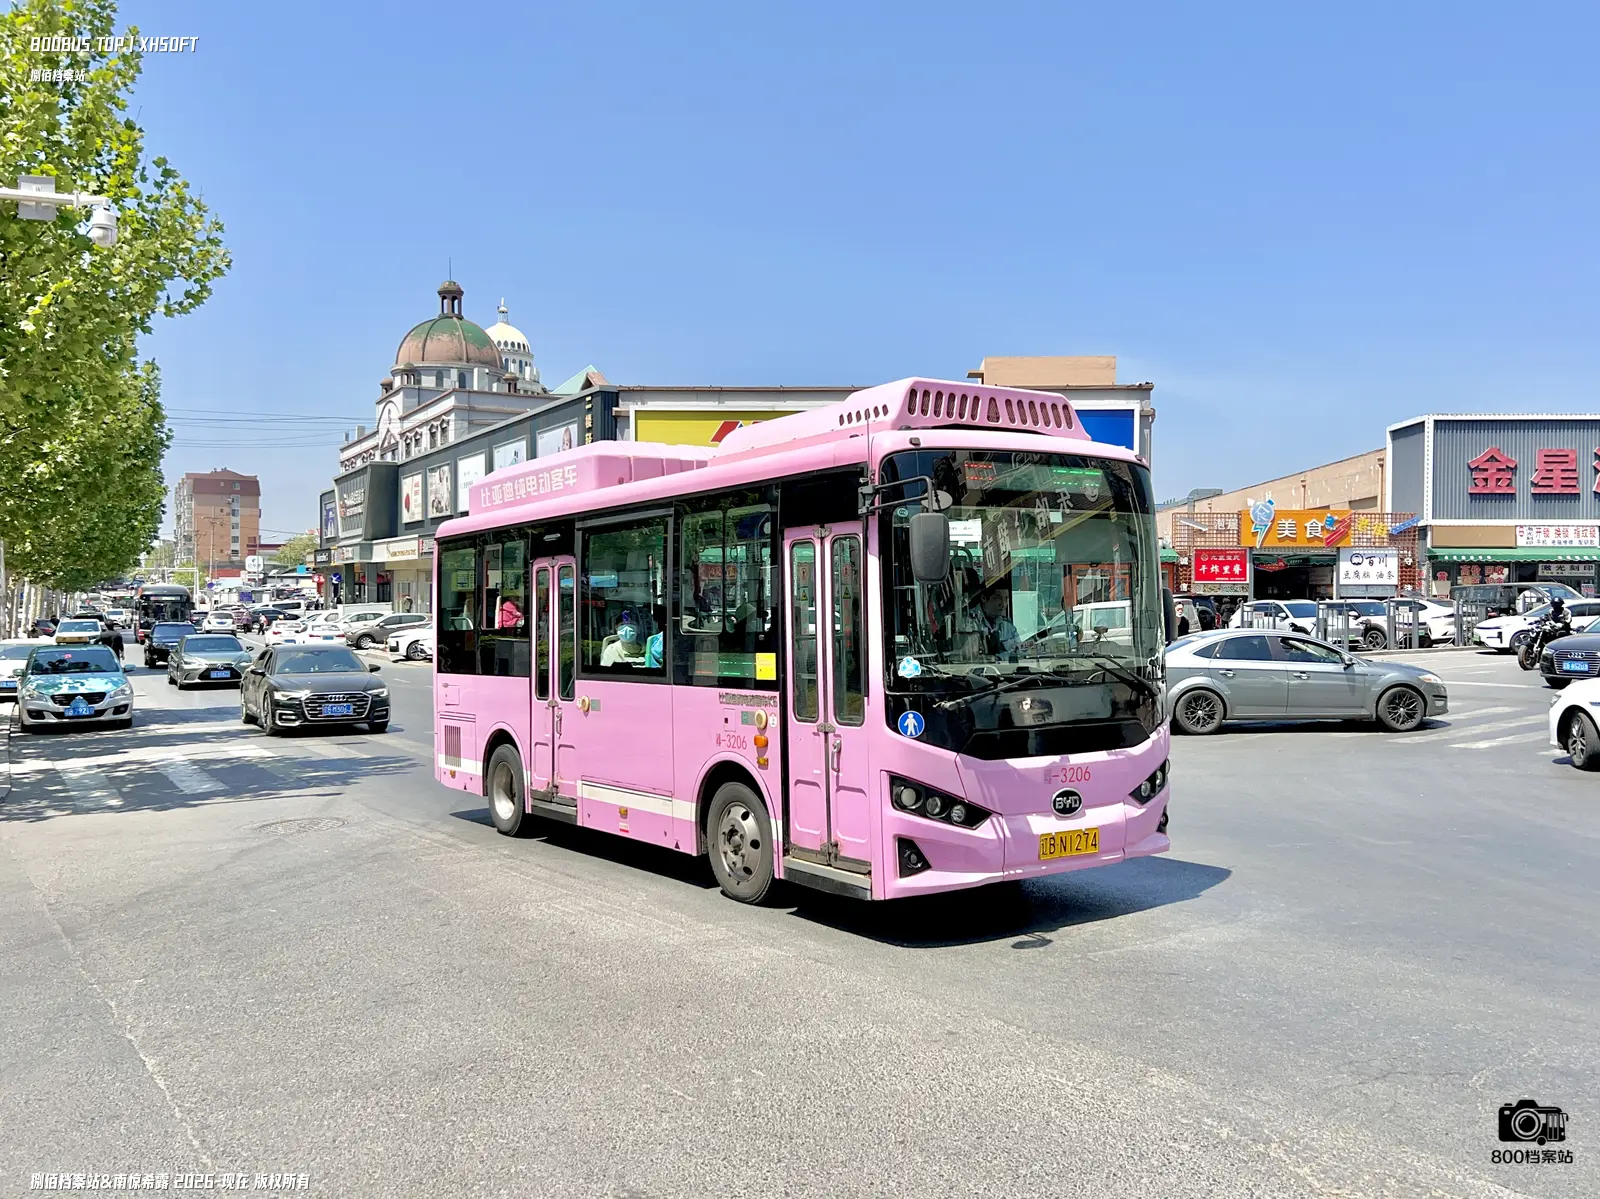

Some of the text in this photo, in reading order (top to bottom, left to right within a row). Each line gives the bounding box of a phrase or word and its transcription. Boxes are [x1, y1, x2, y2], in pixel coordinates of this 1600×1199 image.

[1467, 446, 1600, 495] 金星
[480, 464, 578, 508] 比亚迪纯电动客车
[1276, 518, 1323, 539] 美食
[1535, 527, 1550, 539] 开锁
[1554, 527, 1569, 539] 换锁
[1574, 527, 1597, 539] 指纹锁
[1199, 563, 1243, 575] 干炸里脊
[1484, 565, 1505, 576] 回收
[1541, 564, 1594, 572] 激光刻印
[1342, 570, 1395, 580] 豆腐脑 油条
[716, 733, 748, 750] -3206
[1044, 766, 1091, 785] -3206
[1055, 796, 1080, 809] BYD
